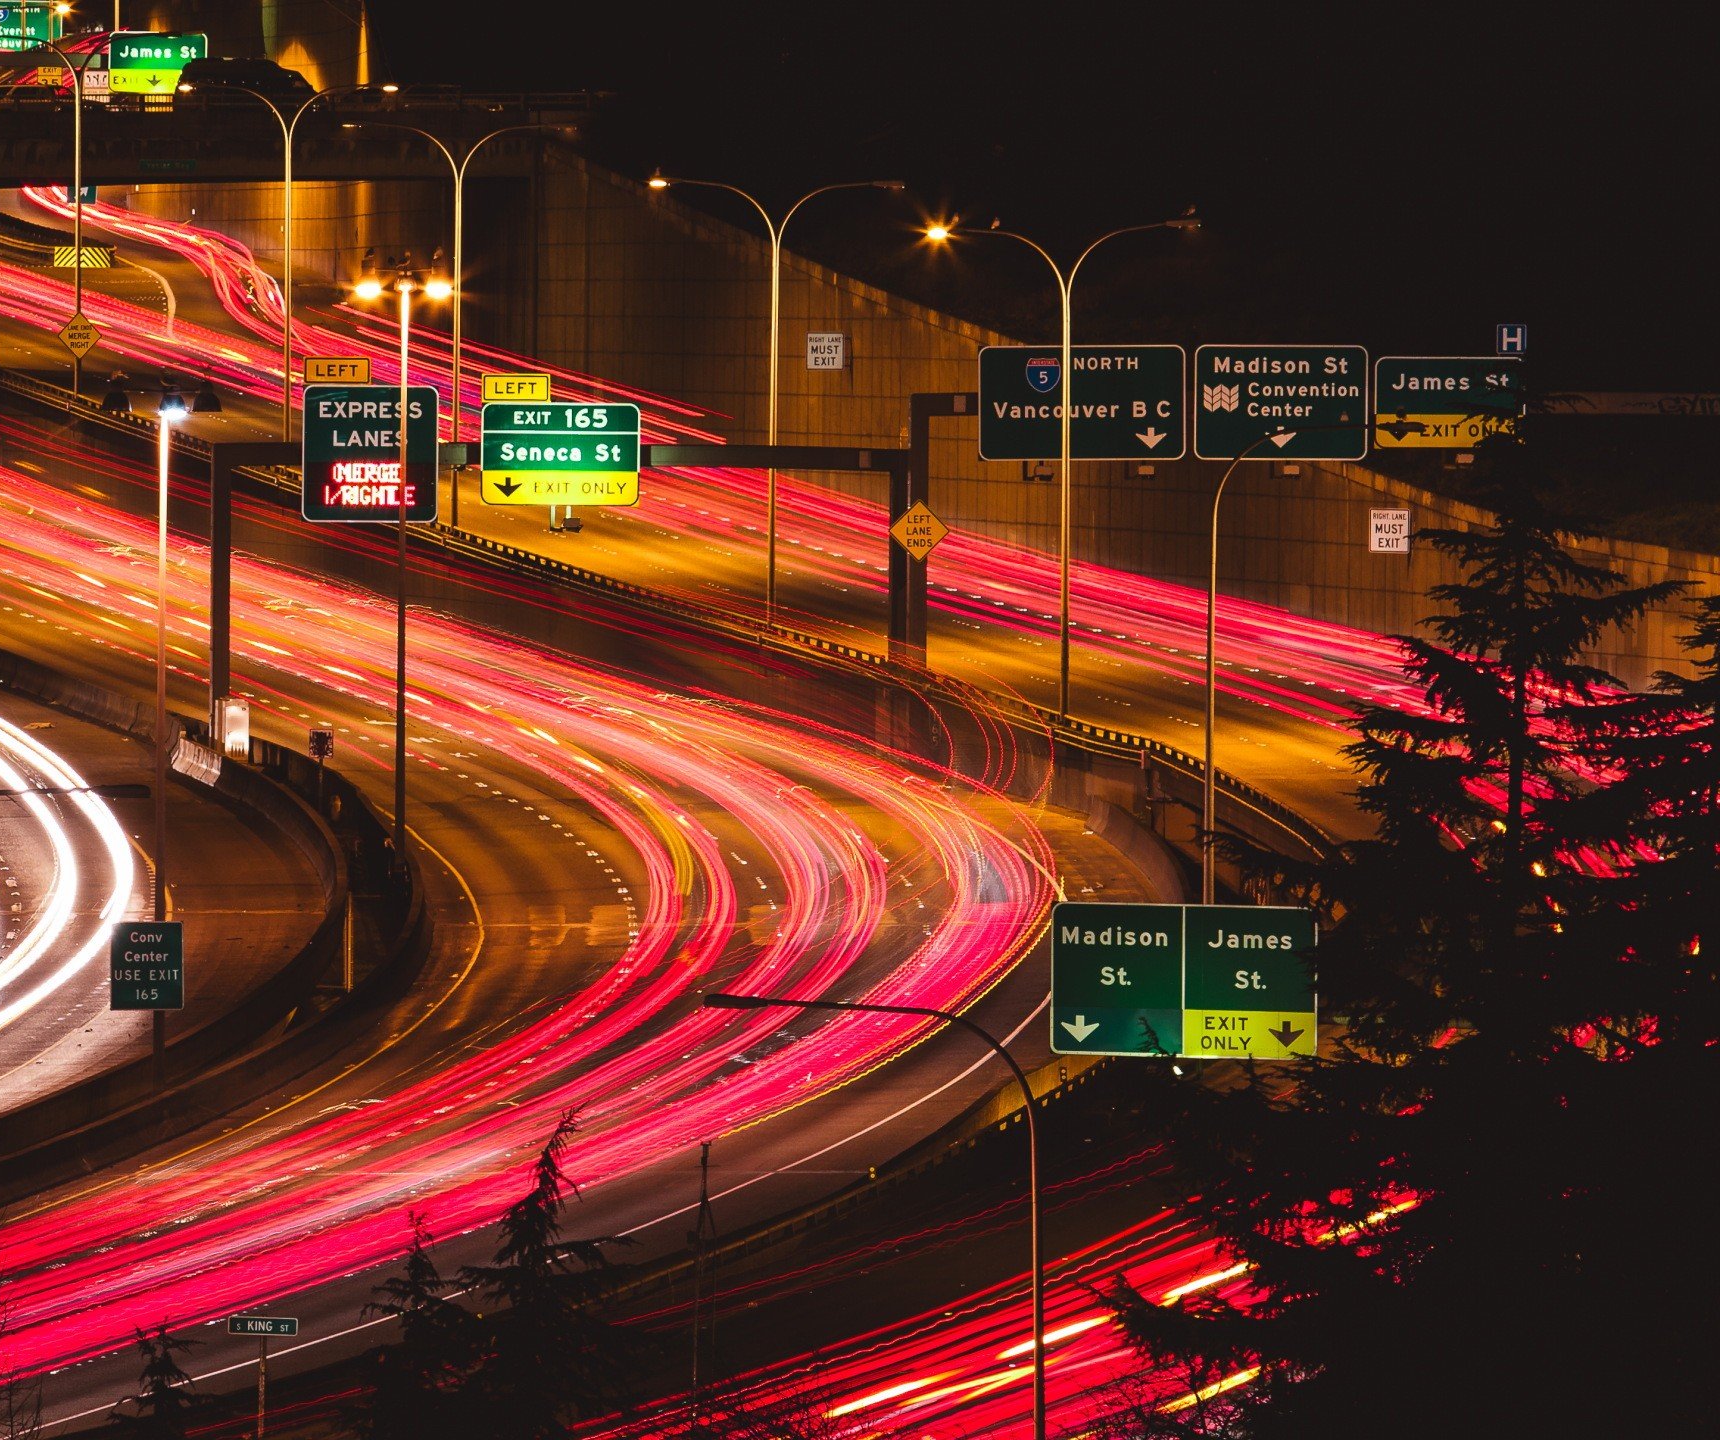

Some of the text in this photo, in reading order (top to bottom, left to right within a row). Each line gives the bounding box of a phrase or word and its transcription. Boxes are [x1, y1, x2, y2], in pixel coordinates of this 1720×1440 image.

[119, 45, 197, 59] James St
[70, 341, 90, 349] RIGHT
[1502, 327, 1522, 351] H
[811, 345, 840, 355] MUST
[814, 356, 836, 366] EXIT
[1073, 357, 1138, 370] NORTH
[1214, 356, 1348, 374] Madison St
[315, 364, 358, 377] LEFT
[1039, 371, 1048, 384] 5
[1392, 373, 1509, 391] James St
[494, 382, 537, 394] LEFT
[1247, 382, 1359, 397] Convention
[319, 401, 423, 419] EXPRESS
[993, 400, 1171, 419] Vancouver B C
[1247, 402, 1313, 417] Center
[513, 408, 608, 429] EXIT 165
[1420, 424, 1461, 437] EXIT
[332, 430, 408, 447] LANES
[500, 442, 621, 462] Seneca St
[534, 482, 627, 495] EXIT ONLY
[907, 515, 931, 524] LEFT
[906, 527, 932, 536] LANE
[1375, 523, 1403, 534] MUST
[907, 539, 933, 548] ENDS
[1378, 537, 1400, 548] EXIT
[130, 931, 163, 943] Conv
[1061, 925, 1169, 947] Madison
[1208, 929, 1293, 950] James
[124, 951, 169, 962] Center
[114, 969, 179, 981] USE EXIT
[1100, 966, 1132, 986] St.
[1234, 970, 1267, 990] St.
[135, 988, 159, 1000] 165
[1204, 1016, 1249, 1031] EXIT
[1201, 1036, 1252, 1051] ONLY
[236, 1320, 289, 1332] S KING ST
